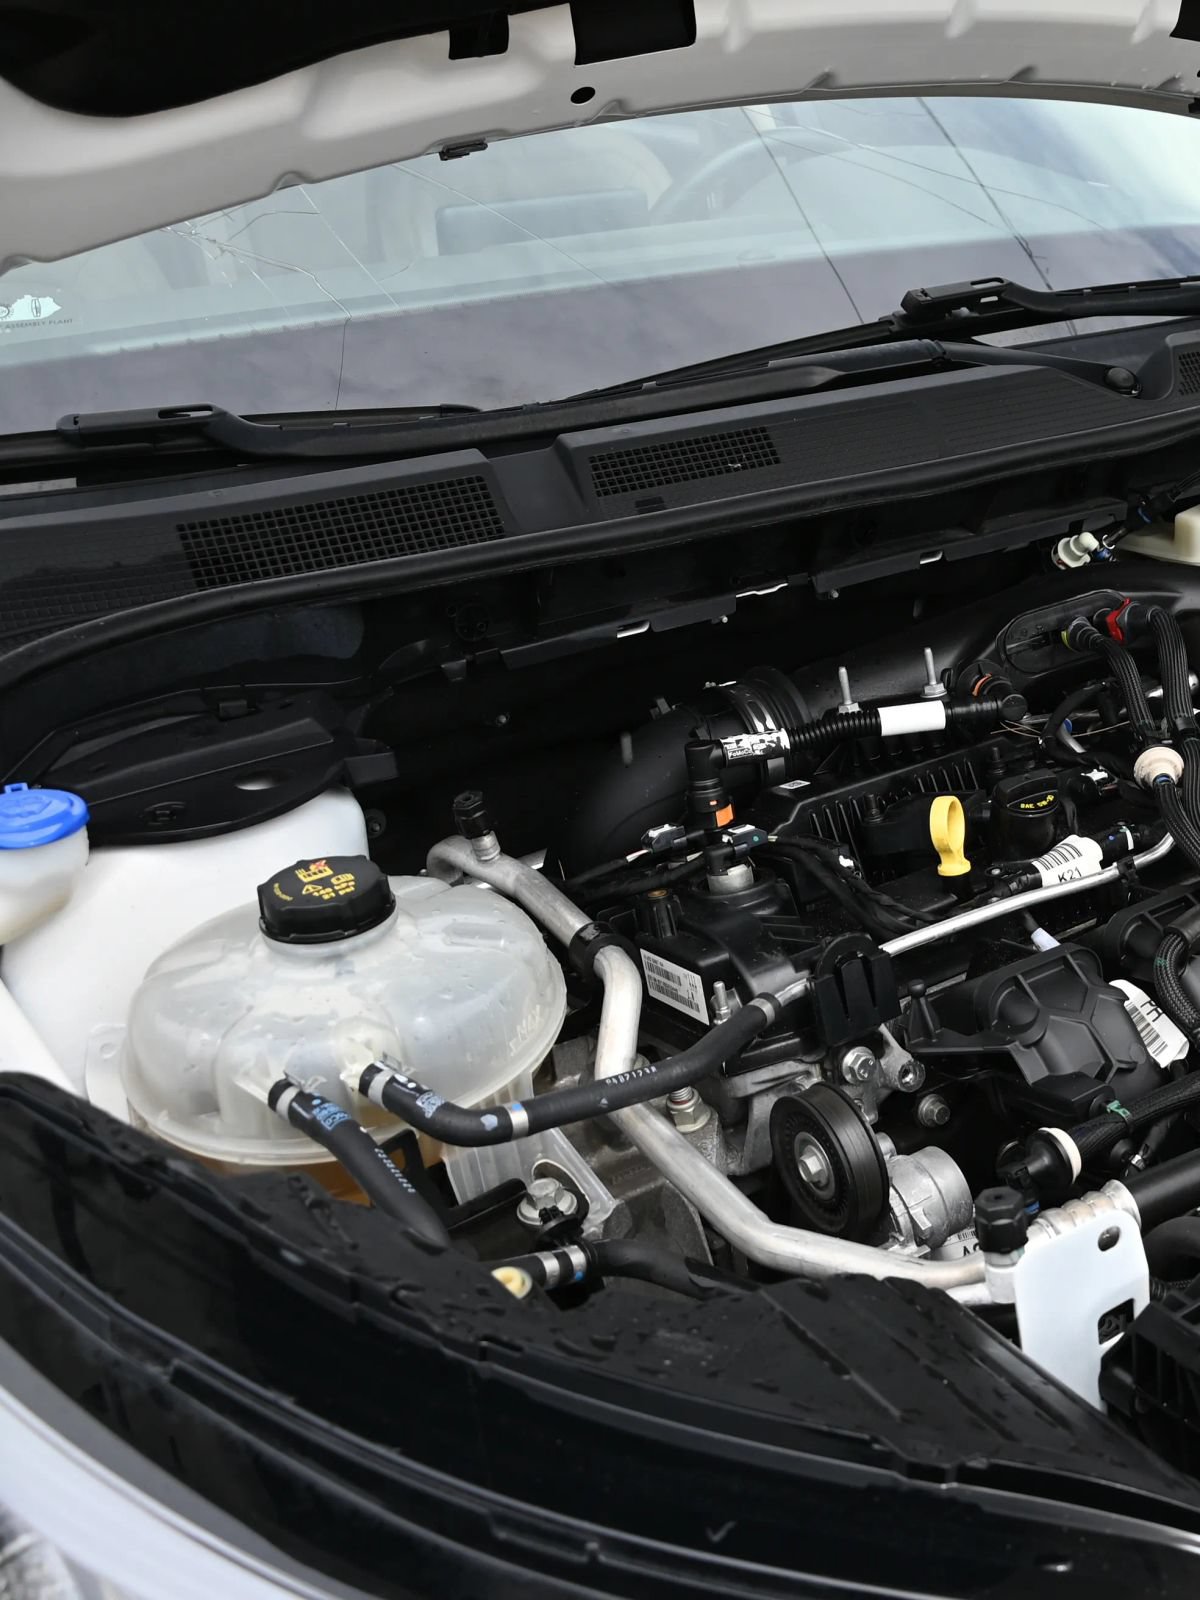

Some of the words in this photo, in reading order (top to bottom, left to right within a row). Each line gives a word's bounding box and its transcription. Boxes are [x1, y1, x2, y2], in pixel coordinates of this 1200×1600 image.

[5, 320, 46, 329] ASSEMBLY
[48, 318, 73, 326] PLANT
[1057, 866, 1082, 883] K21
